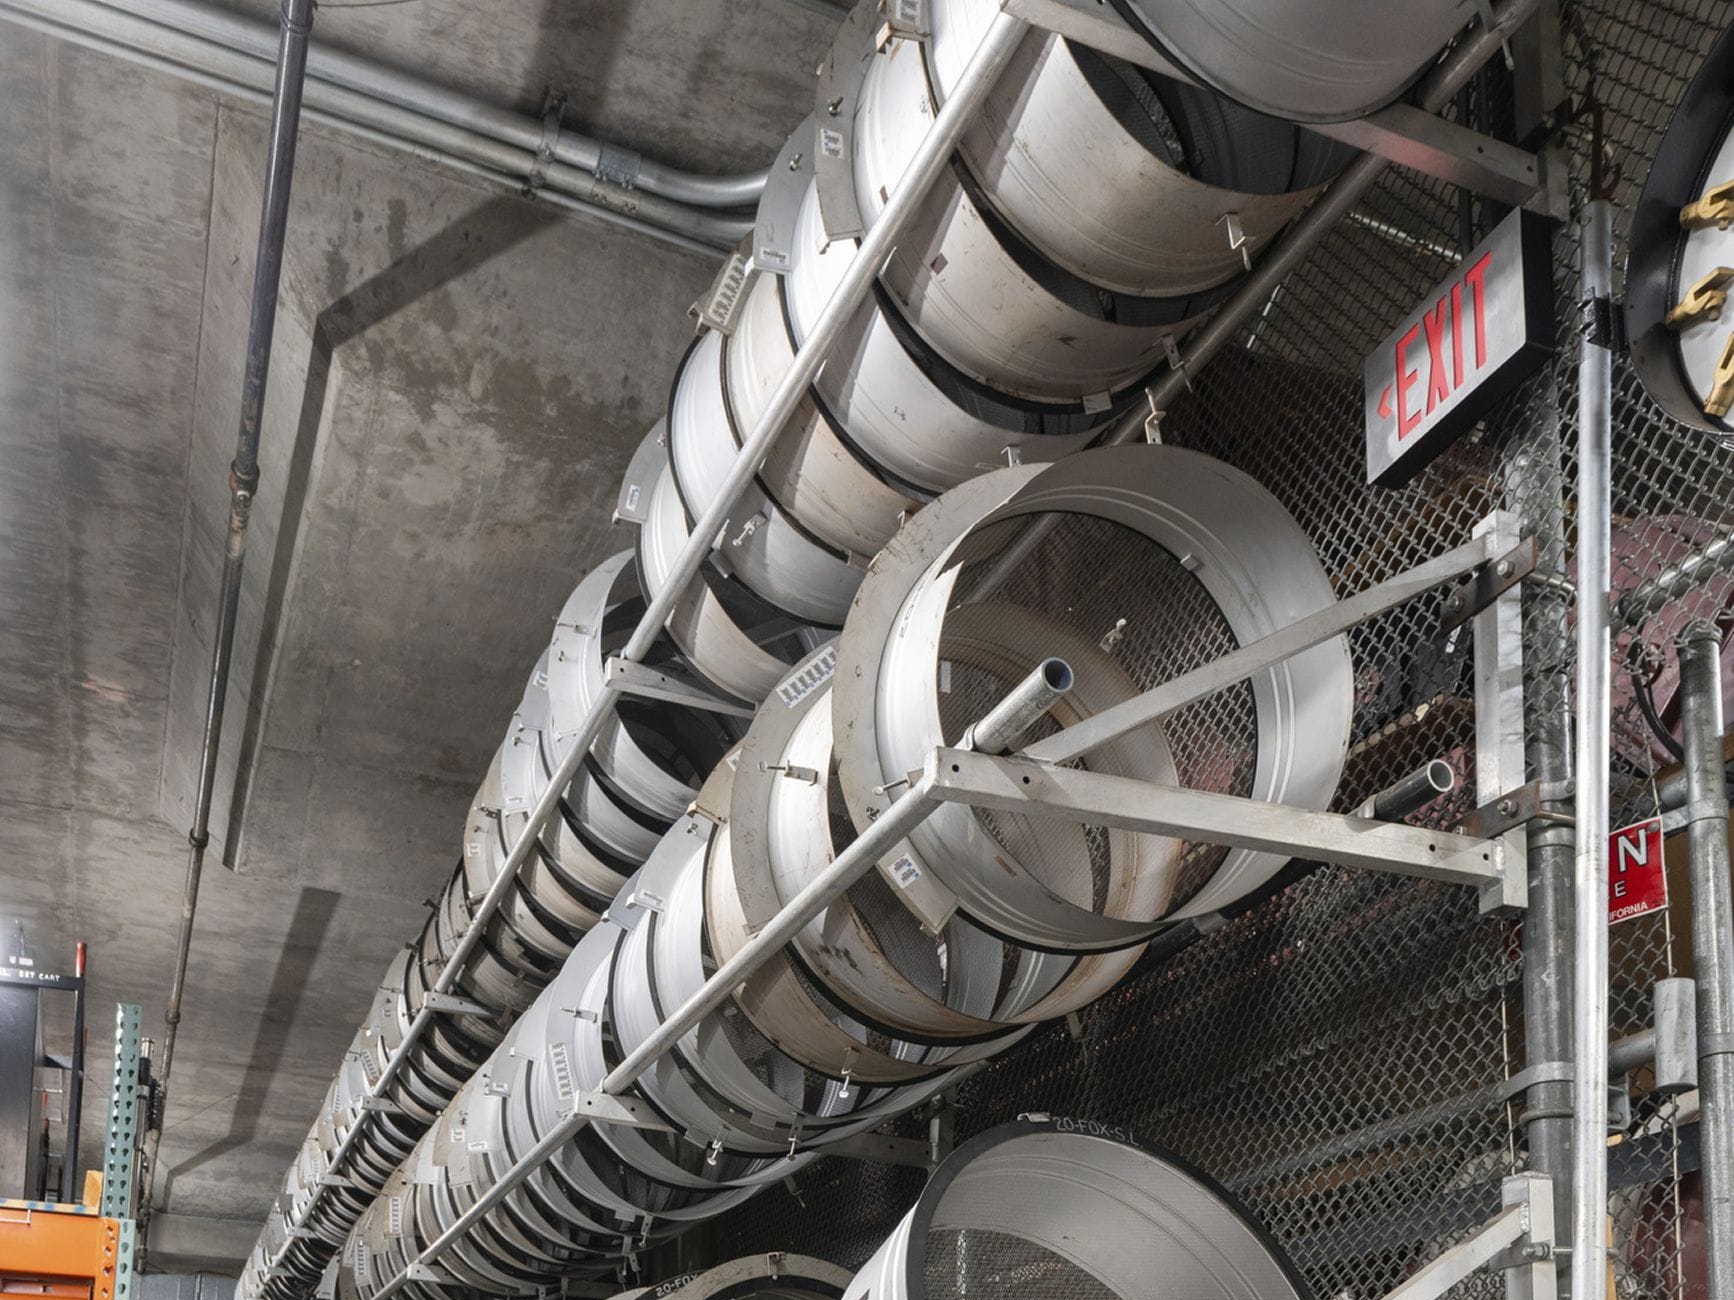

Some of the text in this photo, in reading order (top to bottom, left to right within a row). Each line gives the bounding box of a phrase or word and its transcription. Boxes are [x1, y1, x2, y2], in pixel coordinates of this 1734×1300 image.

[1395, 251, 1493, 442] EXIT
[1609, 901, 1648, 921] IFORNIA
[38, 972, 60, 982] CART
